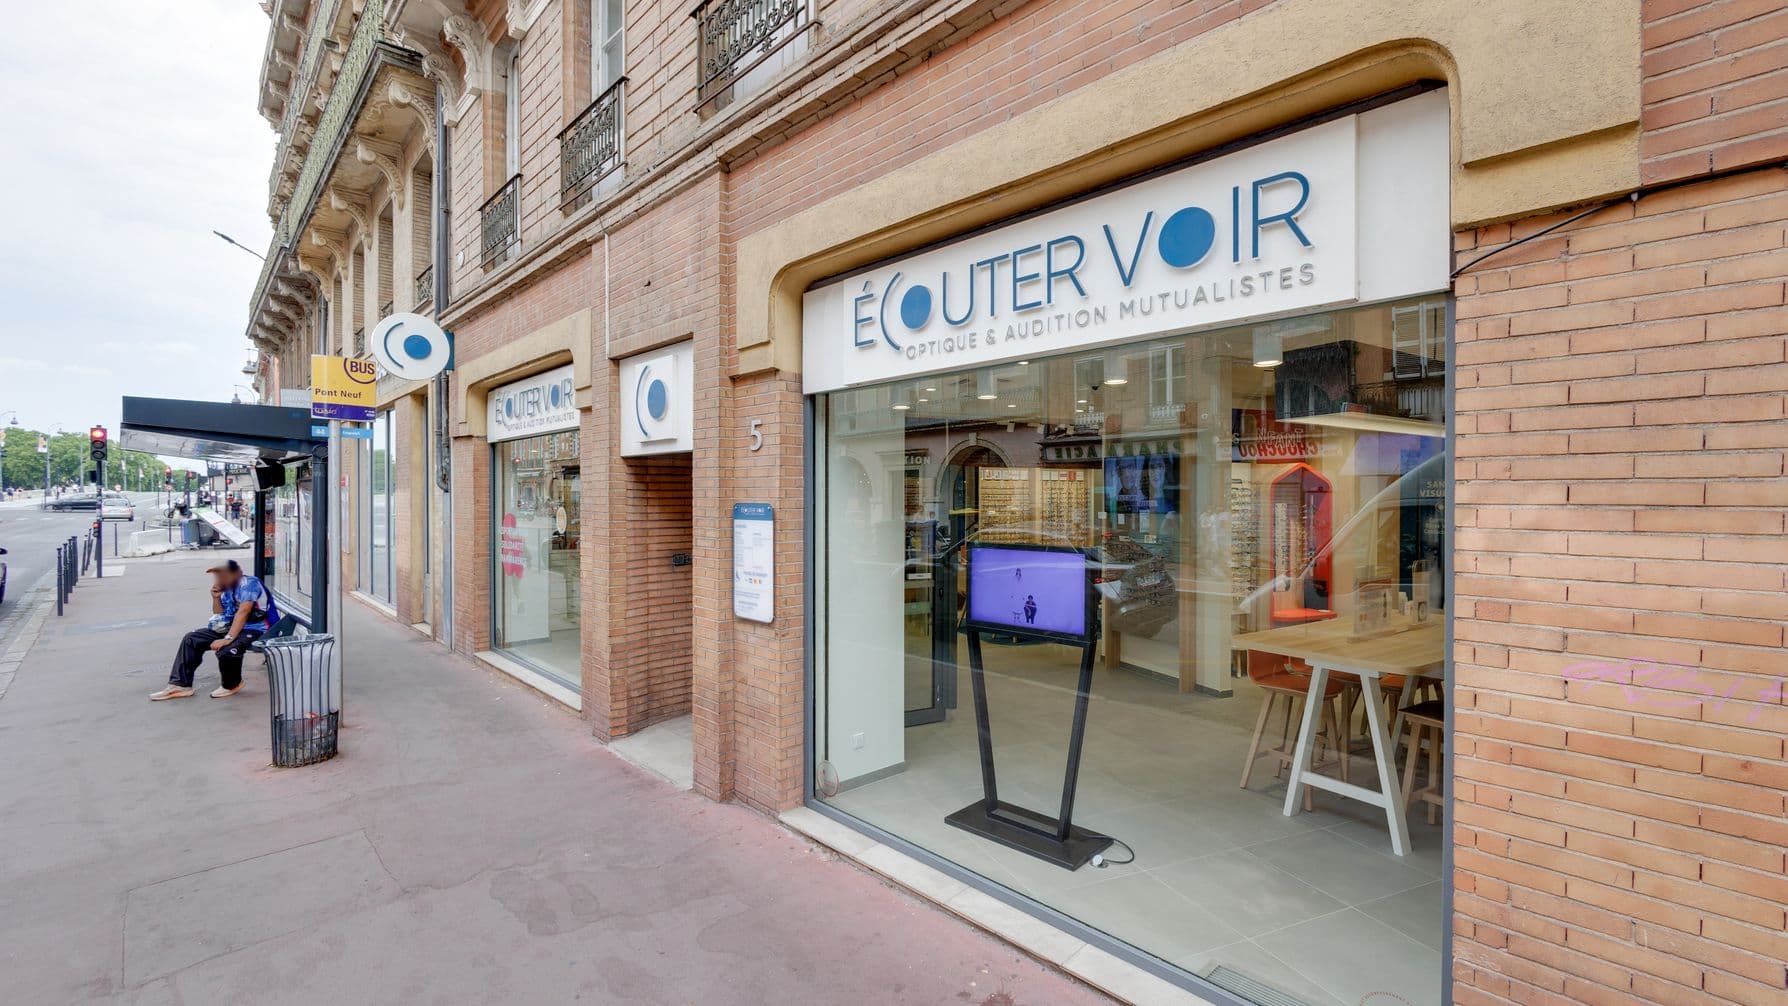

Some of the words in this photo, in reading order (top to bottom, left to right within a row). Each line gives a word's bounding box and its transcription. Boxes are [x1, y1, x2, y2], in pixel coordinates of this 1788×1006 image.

[854, 235, 1087, 351] ÉCOUTER
[1103, 171, 1313, 287] VOIR
[906, 332, 977, 360] OPTIQUE
[986, 328, 996, 345] &
[1005, 305, 1107, 341] AUDITION
[1119, 263, 1315, 319] MUTUALISTES
[350, 361, 375, 375] BUS
[315, 388, 337, 397] Pont
[340, 390, 362, 399] Neuf
[541, 378, 574, 411] VOIR
[750, 419, 762, 451] 5
